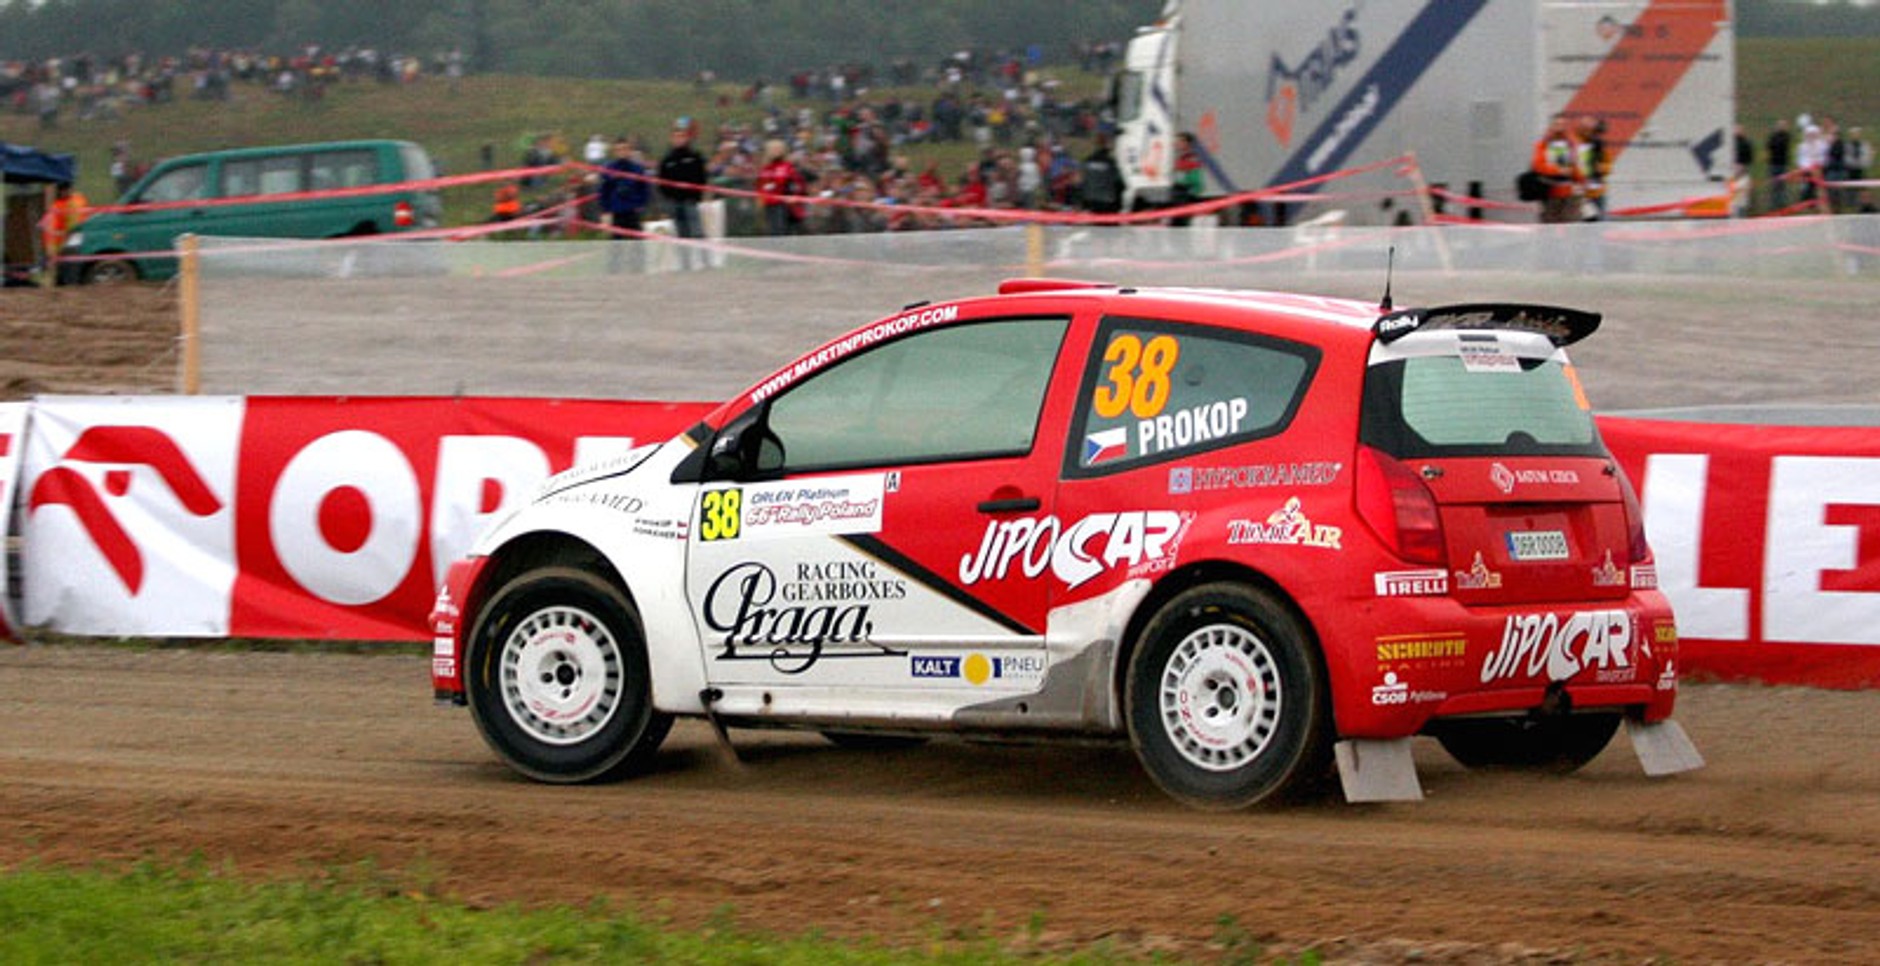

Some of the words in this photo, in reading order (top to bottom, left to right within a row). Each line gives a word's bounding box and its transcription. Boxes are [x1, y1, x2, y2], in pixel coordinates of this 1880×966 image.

[1379, 315, 1420, 333] Rally
[750, 305, 959, 404] WWW.MARTINPROKOP.COM
[1093, 333, 1180, 419] 38
[1138, 397, 1248, 456] PROKOP
[751, 491, 794, 504] ORLEN
[796, 487, 849, 502] Platinum
[702, 489, 740, 541] 38
[777, 502, 816, 526] Rally
[816, 499, 879, 521] Poland
[797, 561, 876, 581] RACING
[1375, 569, 1448, 595] PIRELLI
[782, 580, 906, 602] GEARBOXES
[703, 562, 908, 674] Praga
[914, 659, 953, 674] KALT
[1003, 657, 1043, 672] PNEU
